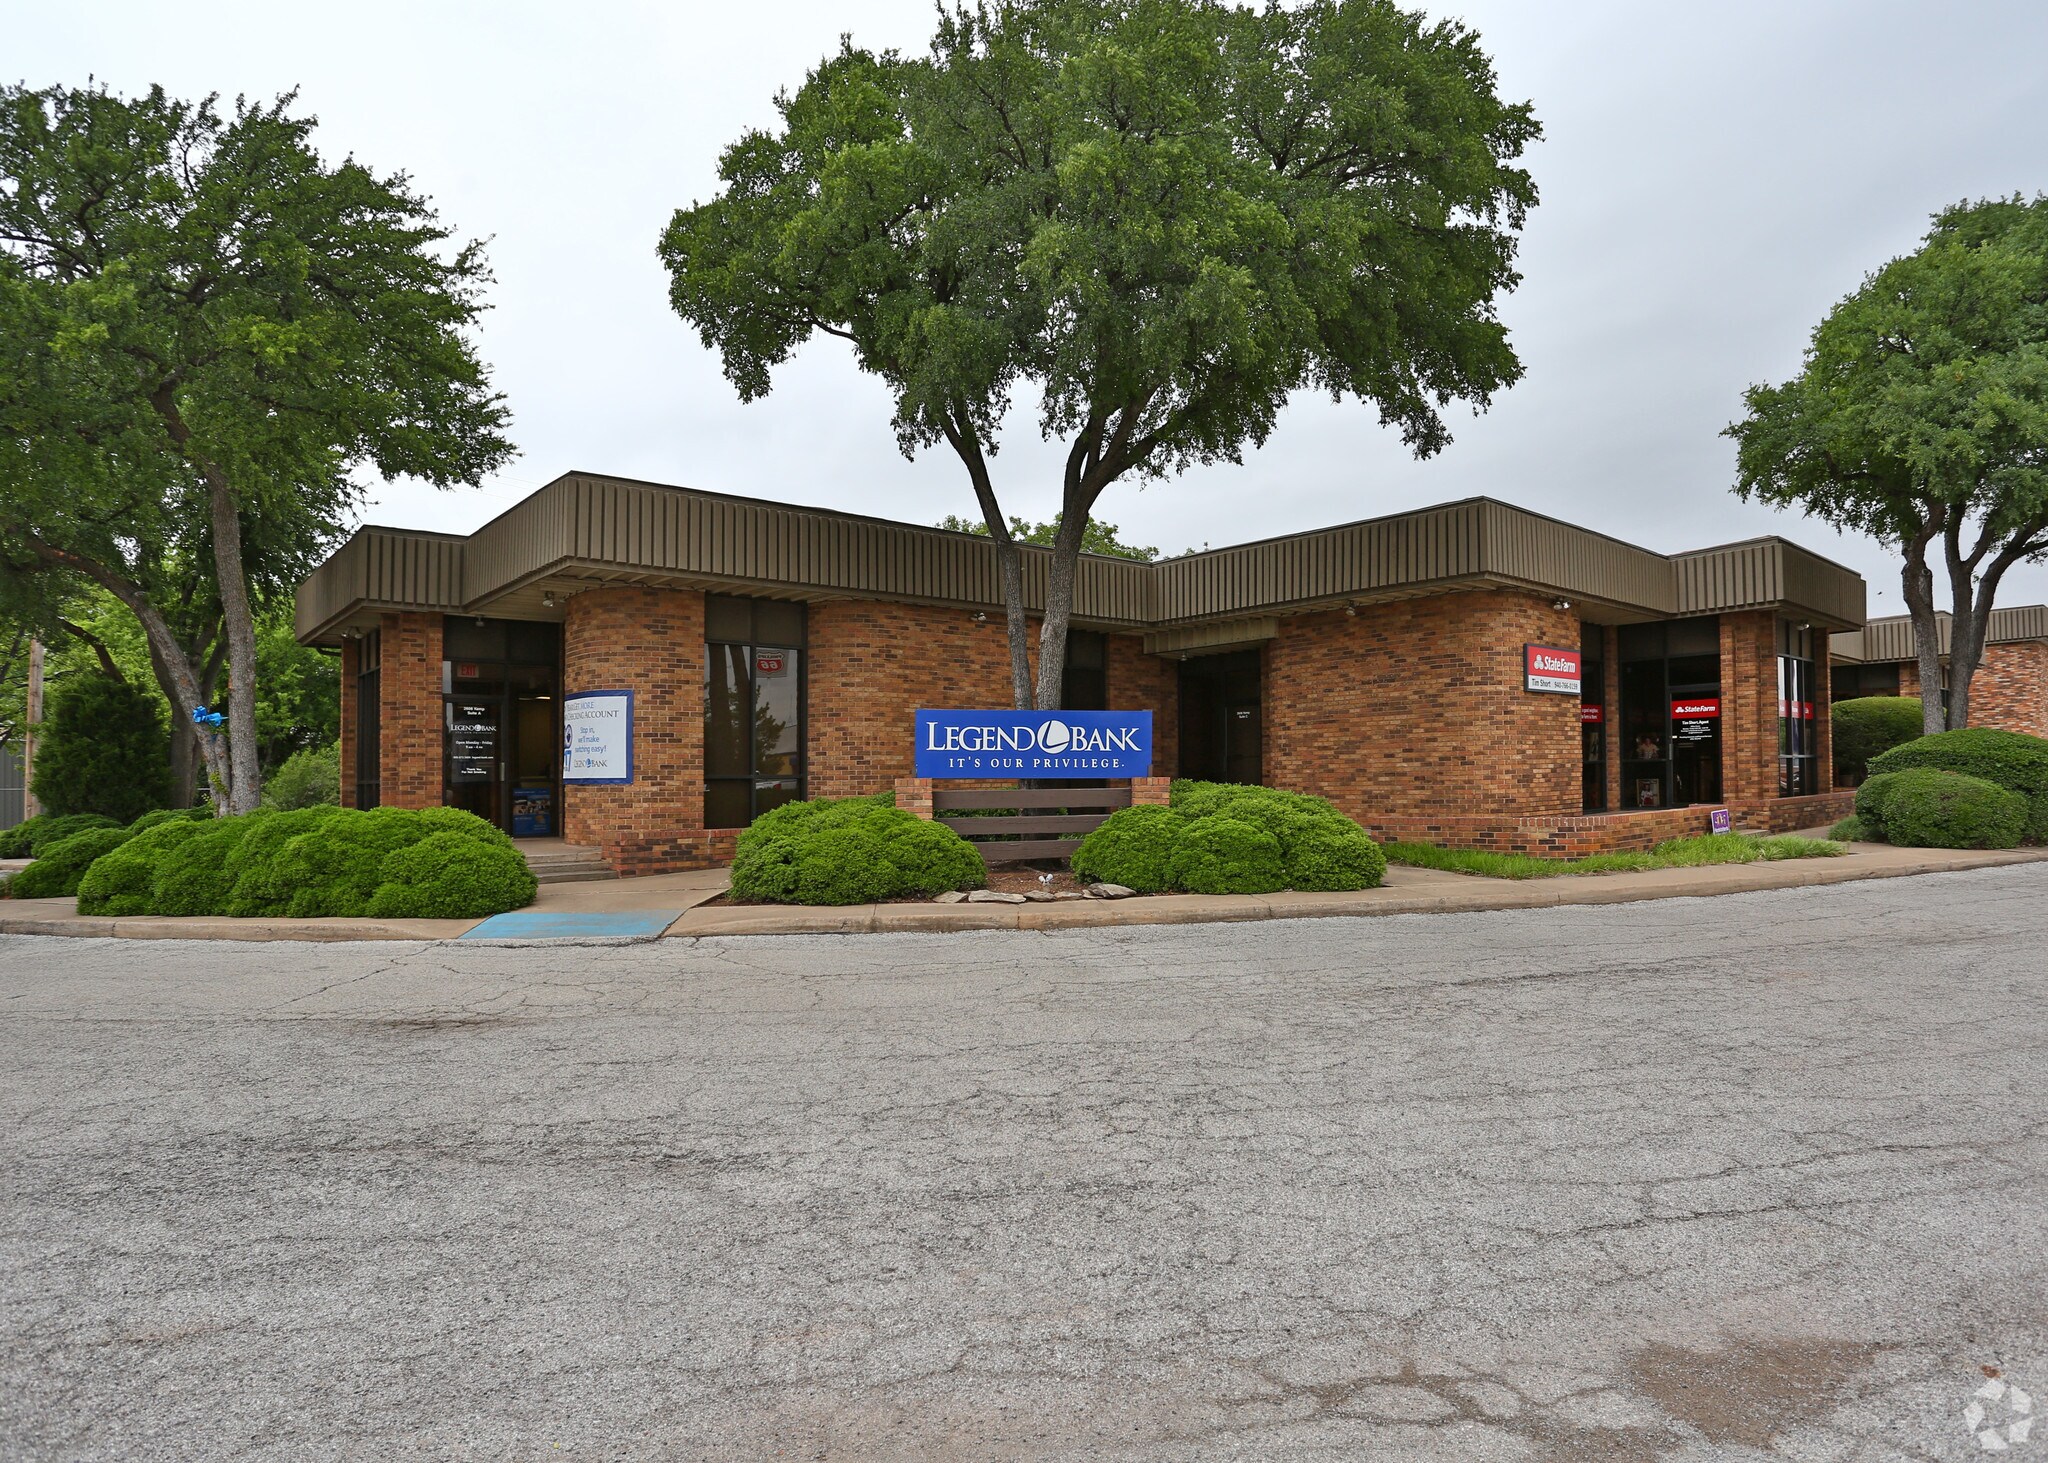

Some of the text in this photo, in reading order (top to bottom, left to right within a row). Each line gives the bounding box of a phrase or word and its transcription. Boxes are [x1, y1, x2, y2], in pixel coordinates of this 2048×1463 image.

[461, 665, 475, 676] EXIT
[1532, 678, 1540, 686] Tim
[1540, 679, 1551, 687] Short
[584, 710, 619, 719] ACCOUNT
[451, 723, 475, 731] LEGEND
[926, 721, 1142, 751] LEGEND BANK
[949, 756, 1125, 768] IT'S OUR PRIVILEGE.
